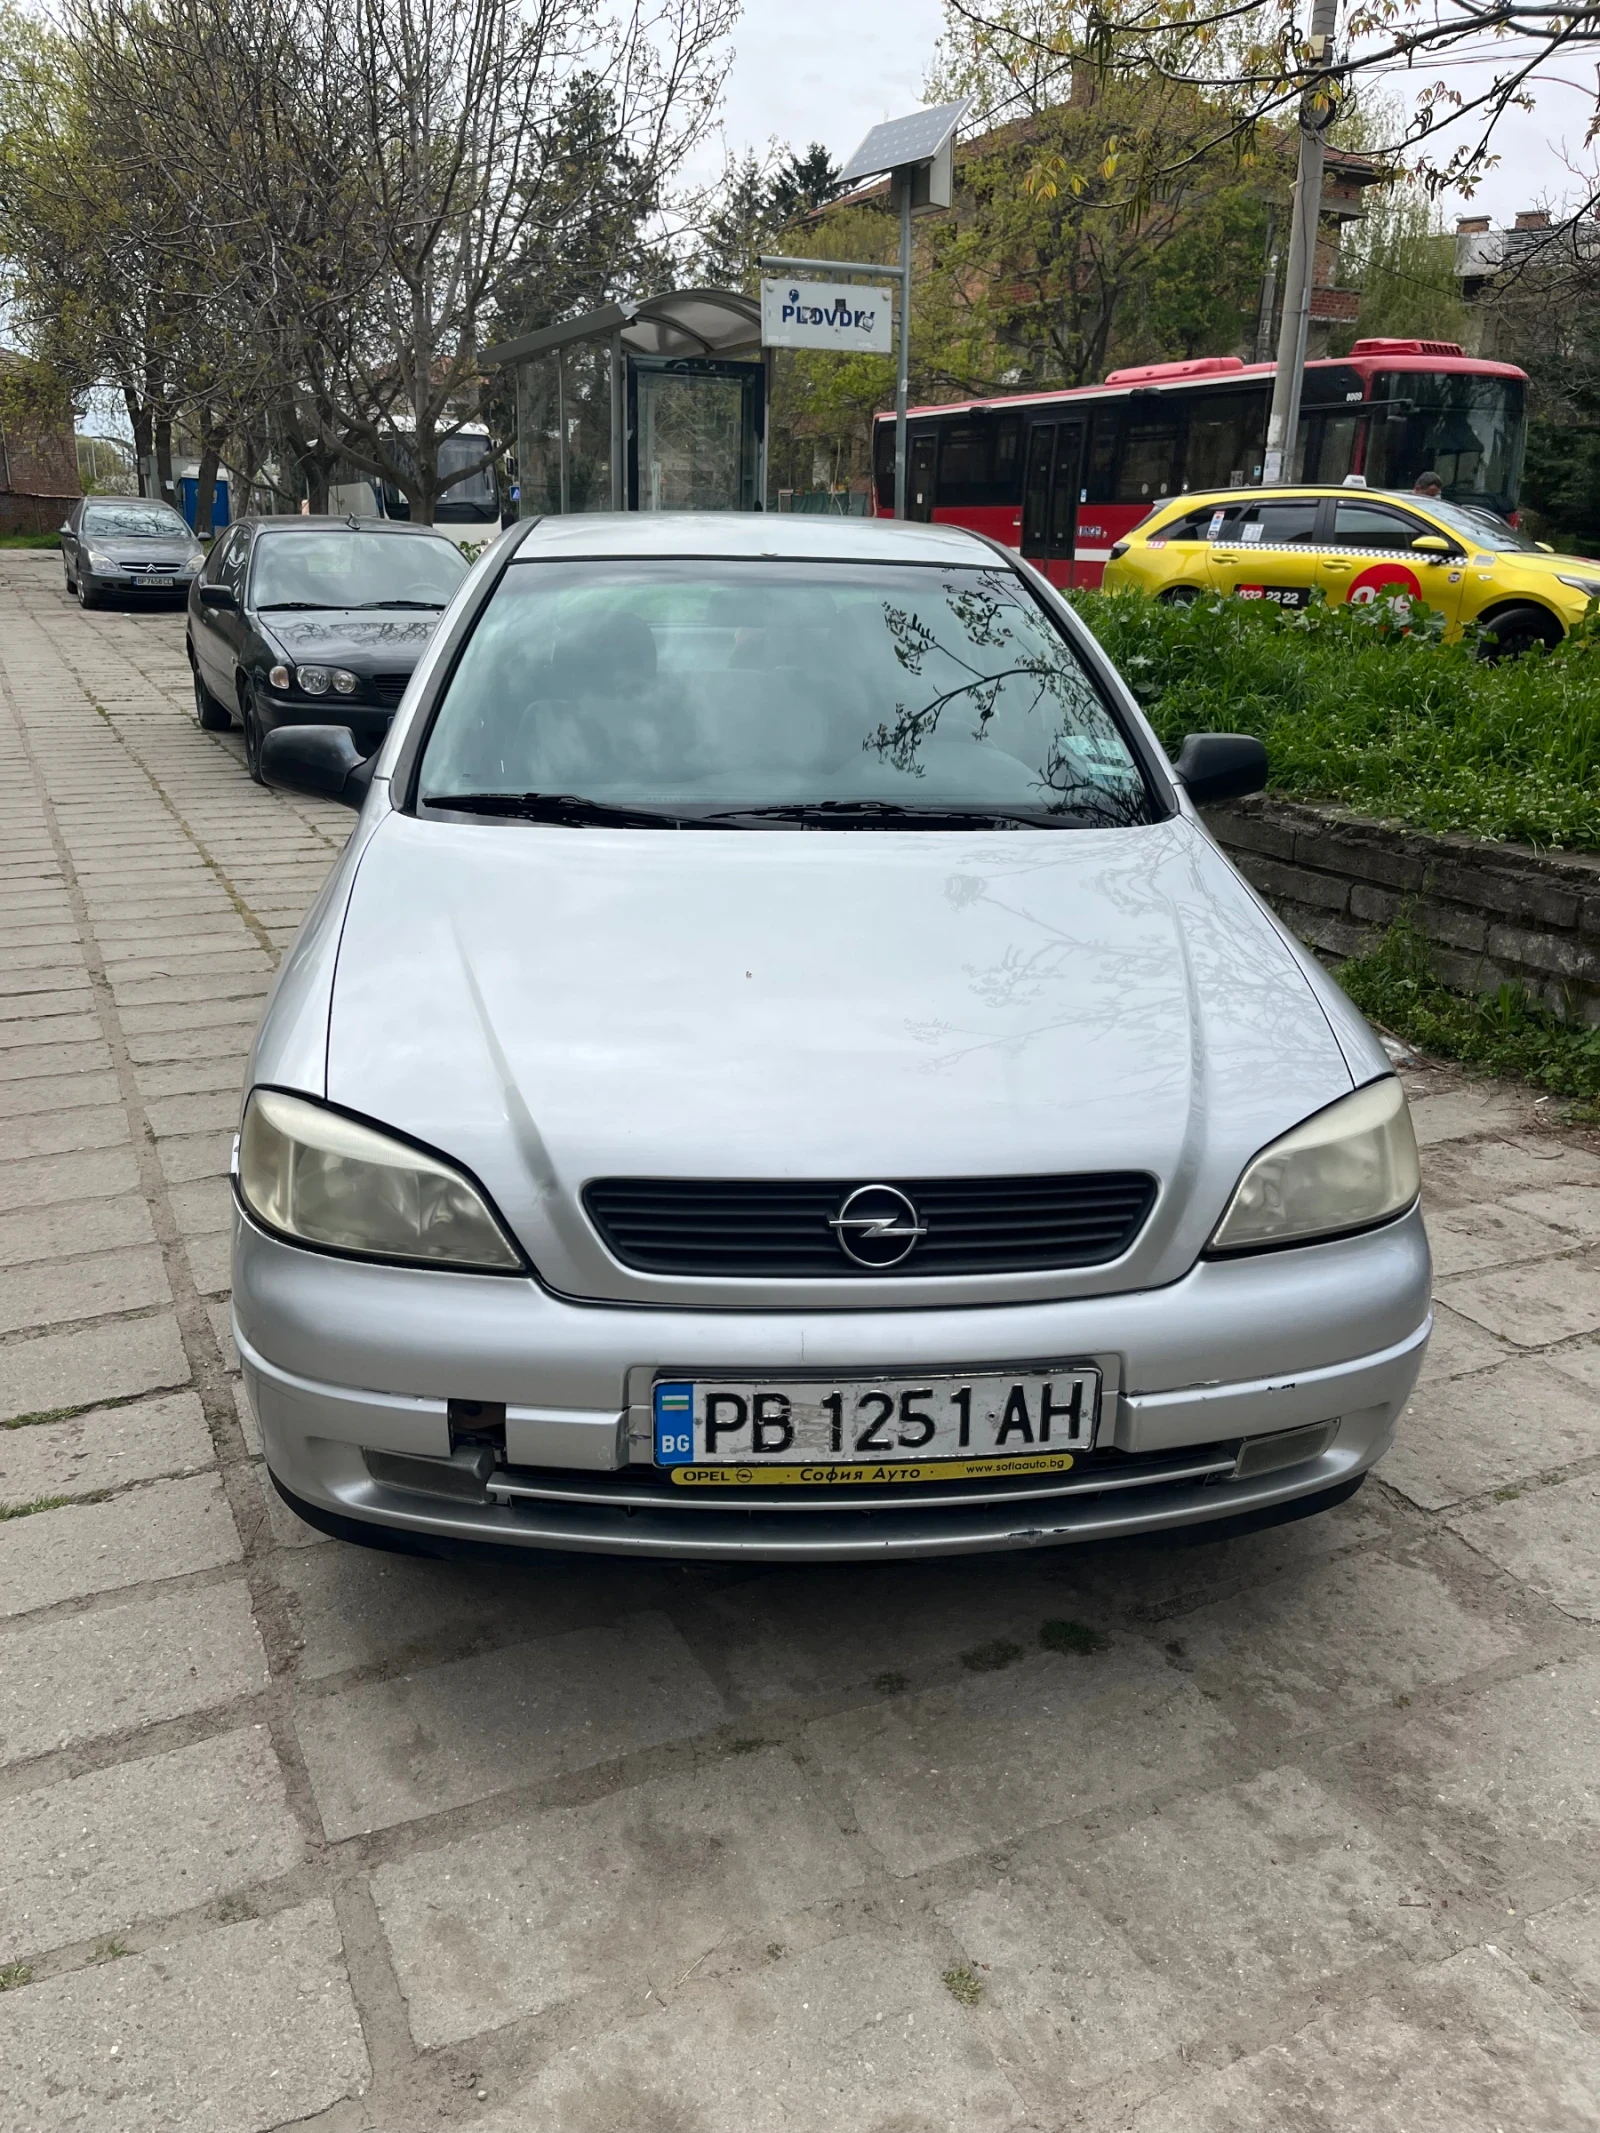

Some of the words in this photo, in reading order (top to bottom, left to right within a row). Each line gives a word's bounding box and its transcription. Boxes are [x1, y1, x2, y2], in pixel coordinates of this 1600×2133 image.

[1266, 591, 1281, 603] 22
[1282, 592, 1299, 604] 22
[705, 1392, 795, 1453] PB
[822, 1385, 972, 1453] 1251
[995, 1380, 1084, 1446] AH
[662, 1435, 690, 1453] BG
[966, 1458, 1065, 1474] www.sofiaauto.bg
[683, 1470, 730, 1481] OPEL
[800, 1467, 863, 1484] София
[872, 1467, 921, 1482] Ауто
